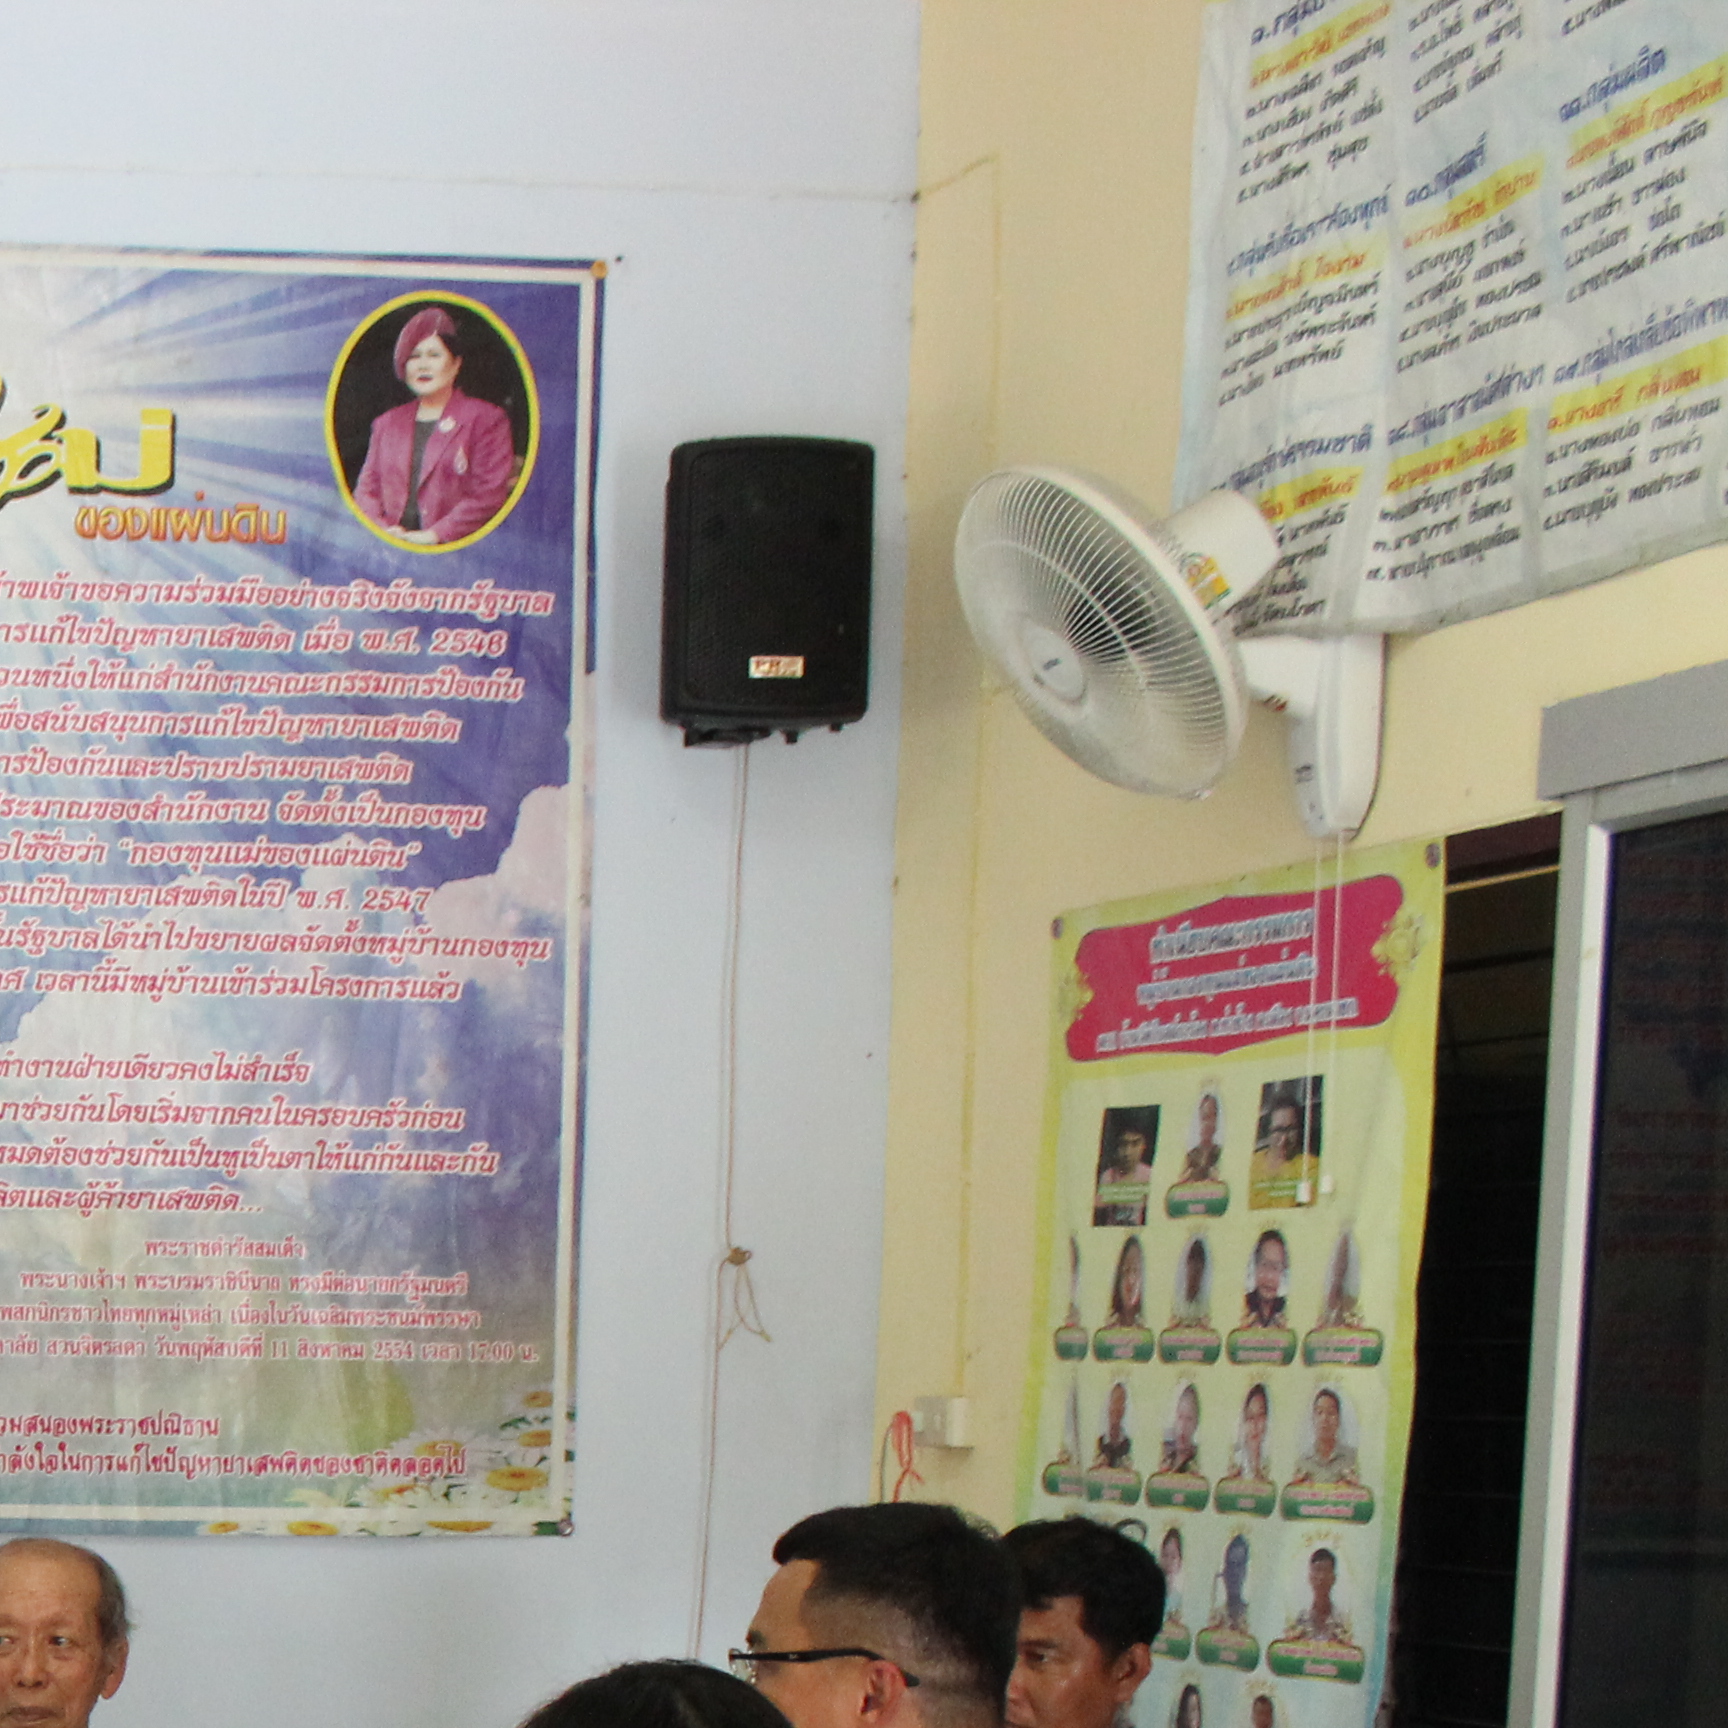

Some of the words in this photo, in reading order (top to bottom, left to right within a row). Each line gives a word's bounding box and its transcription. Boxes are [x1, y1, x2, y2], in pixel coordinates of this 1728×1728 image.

[75, 491, 287, 545] ของแผ่นดิน
[302, 617, 352, 653] เมื่อ
[360, 630, 421, 656] พ.ศ.
[361, 887, 434, 914] 2547
